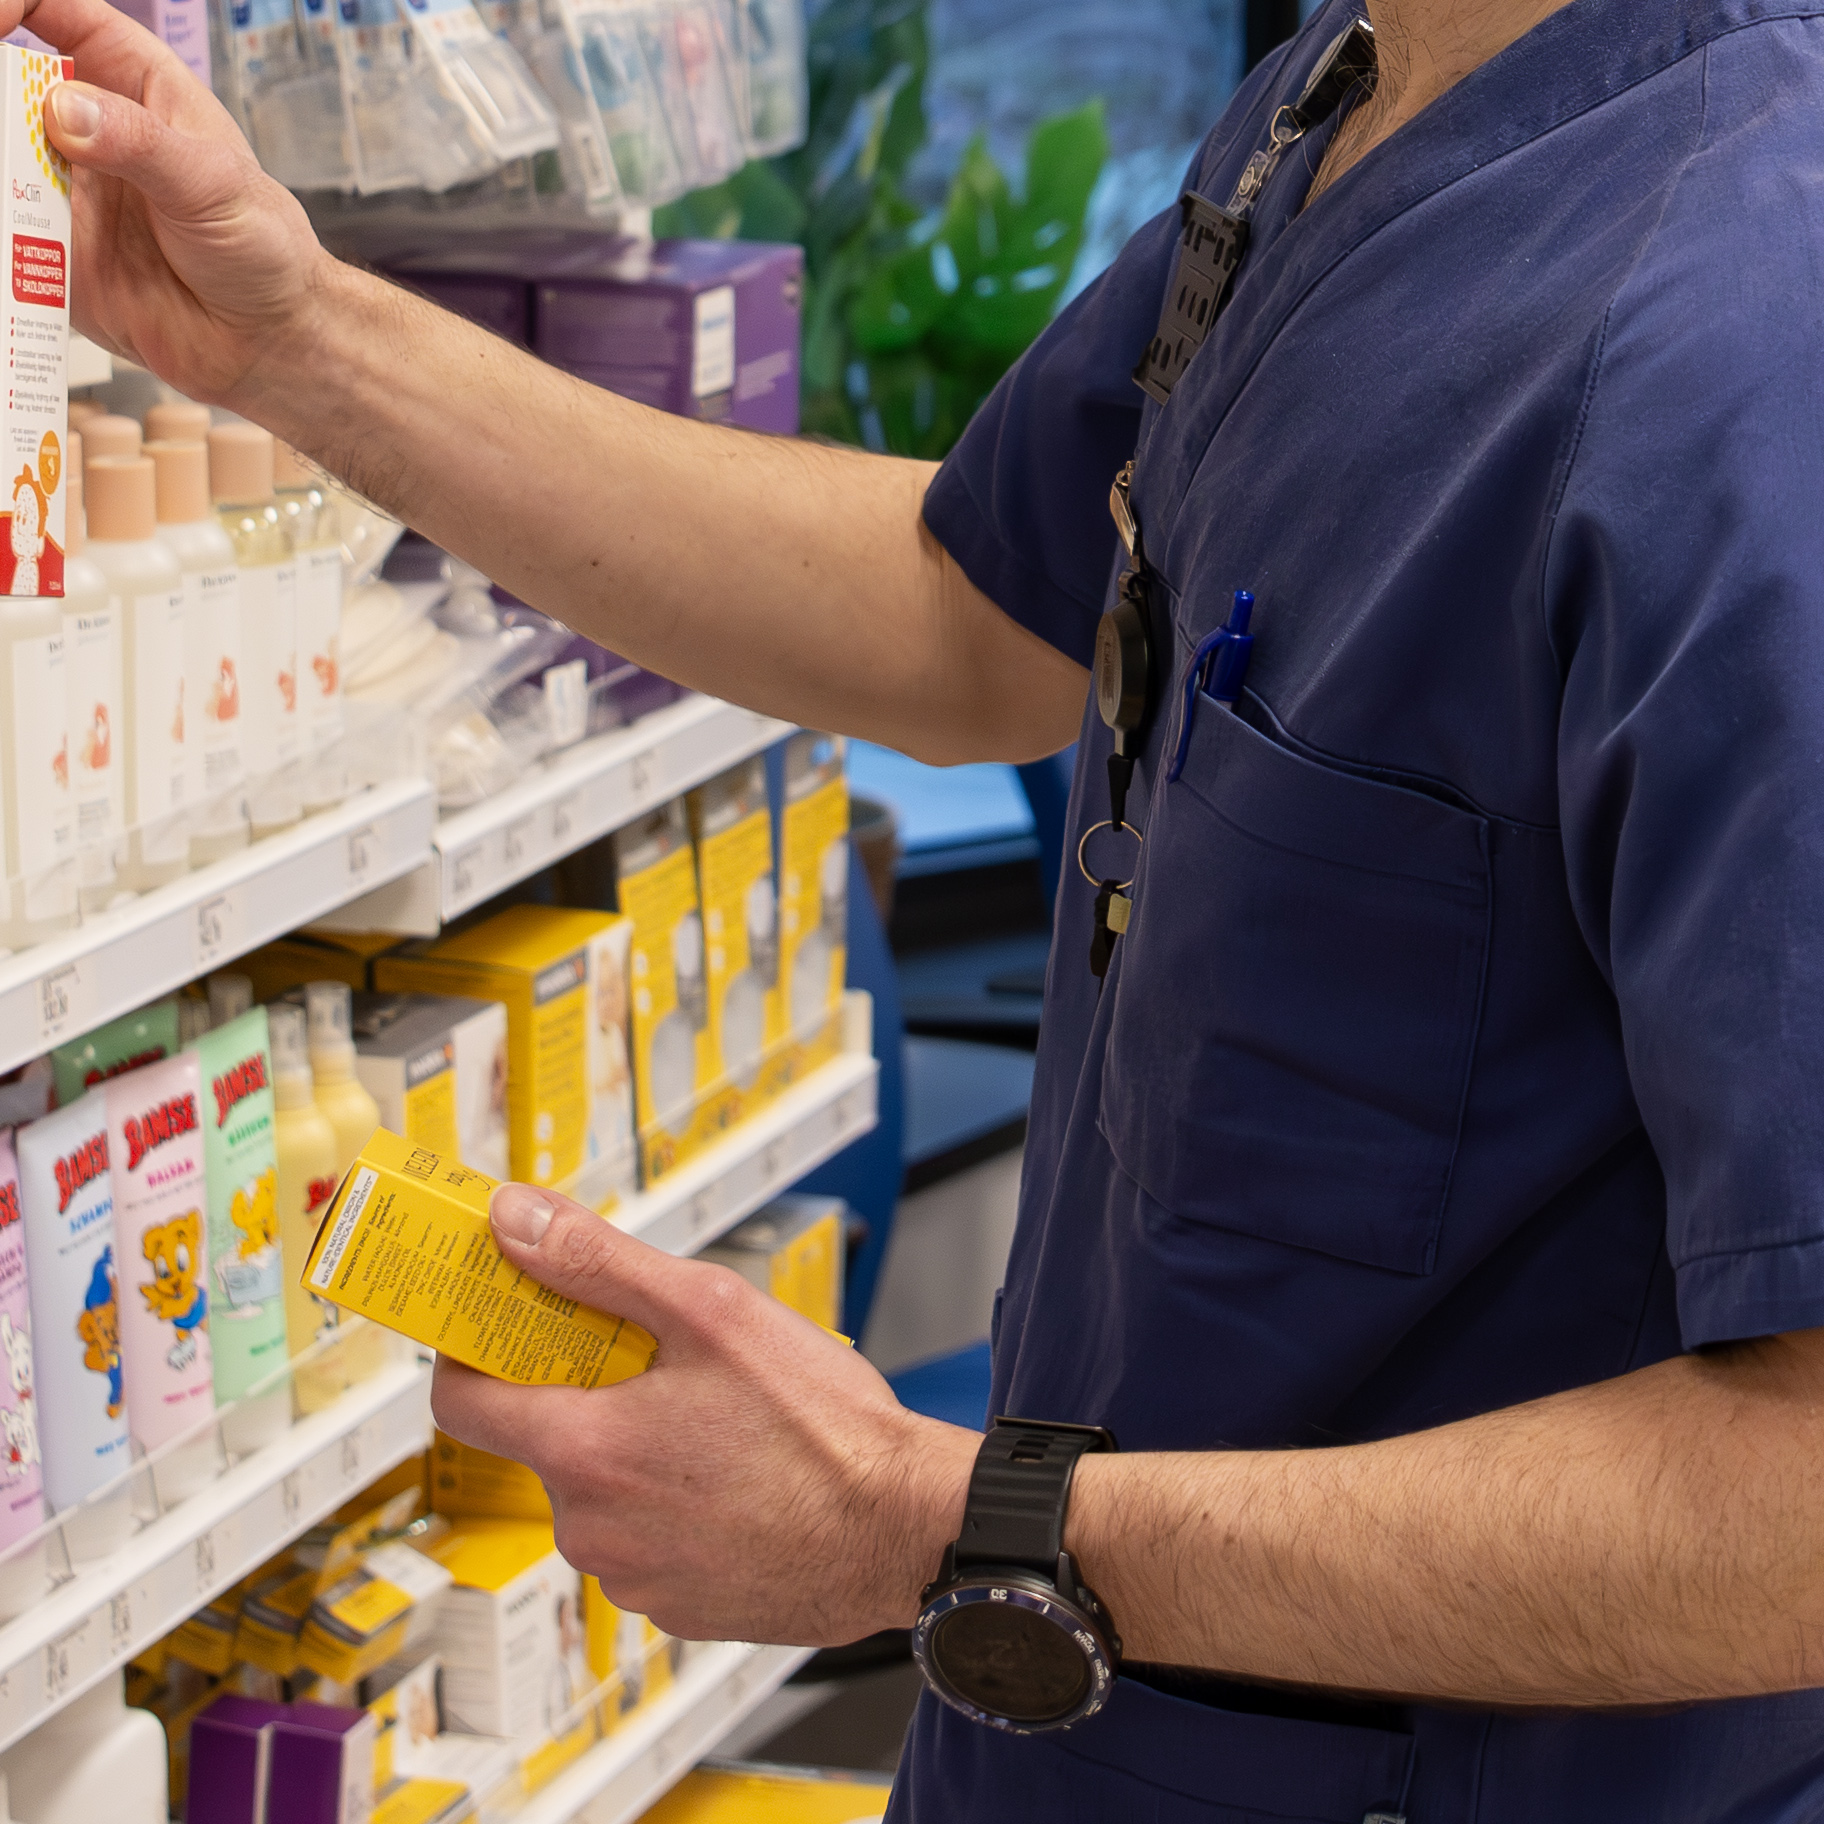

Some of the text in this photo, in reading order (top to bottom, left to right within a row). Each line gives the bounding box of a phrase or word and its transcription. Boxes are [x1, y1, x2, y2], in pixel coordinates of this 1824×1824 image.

[12, 177, 42, 203] PoxClin
[12, 209, 51, 230] CoolMousse
[22, 242, 62, 264] VATTKOPPOR
[22, 259, 64, 281] VANNKOPPER
[123, 1092, 198, 1172] BAMSE
[328, 1193, 358, 1249] NATURAL ORIGIN
[319, 1220, 355, 1285] NATURE-IDENTICAL
[337, 1246, 363, 1291] INGREDIENTS
[367, 1201, 383, 1226] Source
[990, 1588, 1008, 1601] 30
[1073, 1629, 1097, 1654] DOWN
